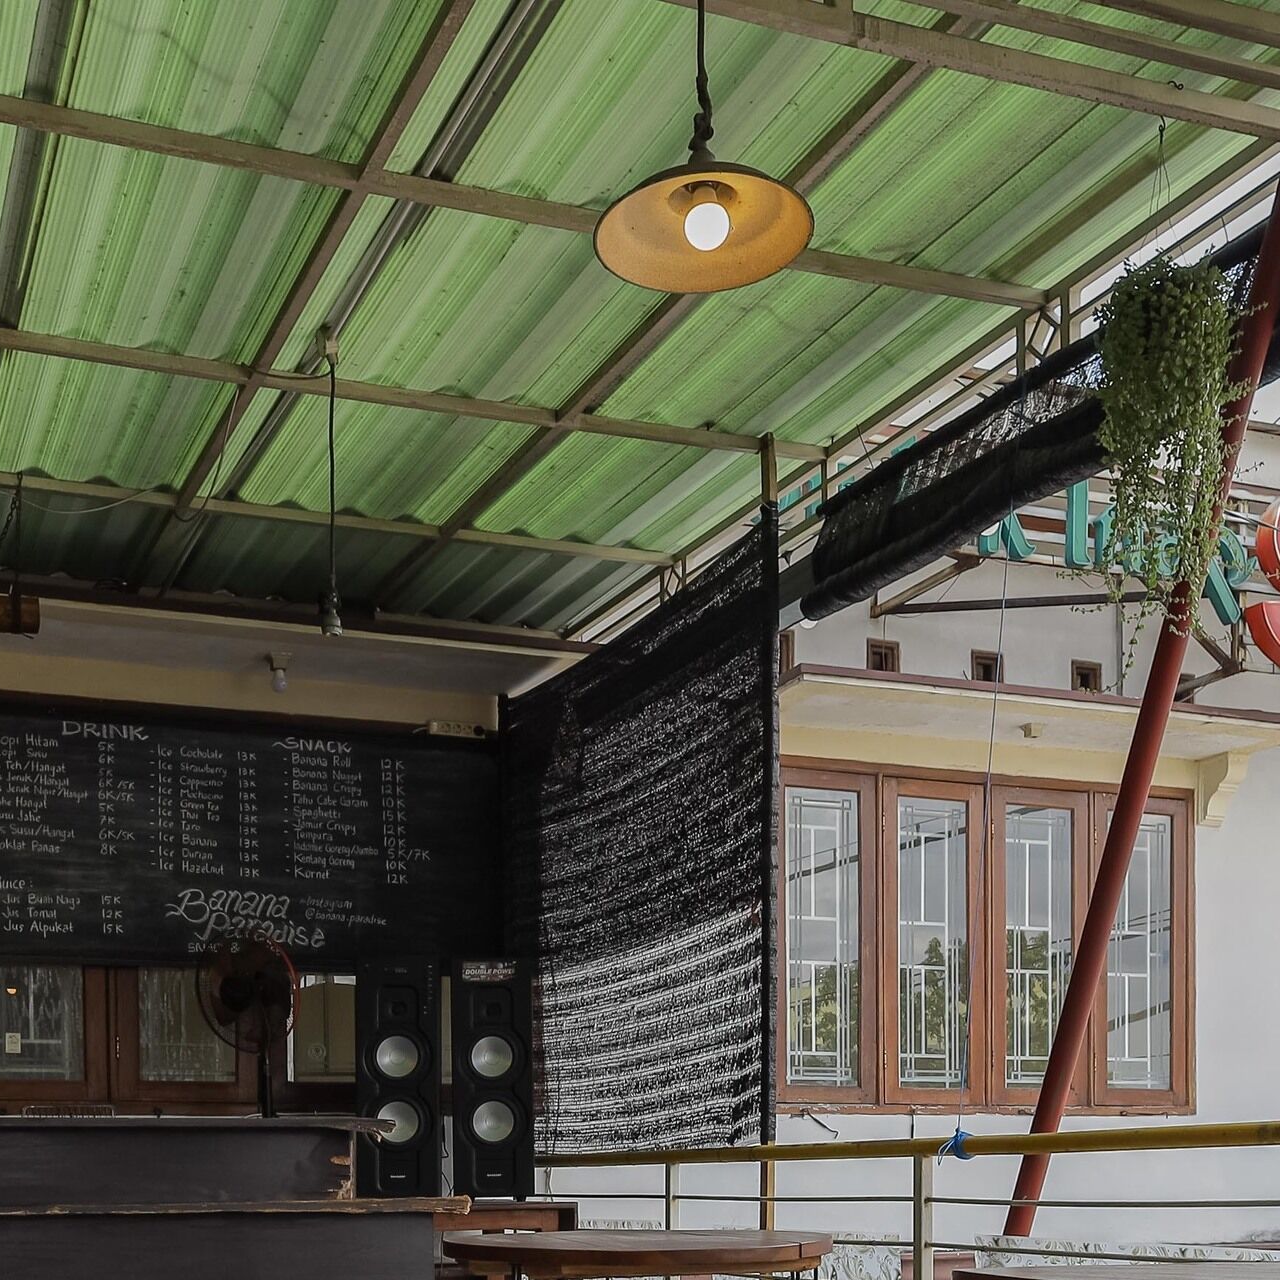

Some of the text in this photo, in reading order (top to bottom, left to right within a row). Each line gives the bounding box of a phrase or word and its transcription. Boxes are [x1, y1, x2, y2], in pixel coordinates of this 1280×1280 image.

[61, 721, 149, 741] DRINK
[25, 733, 59, 747] Hitam
[98, 741, 115, 752] 5K
[157, 744, 172, 757] Ice
[272, 737, 353, 754] SNACK
[26, 748, 48, 759] Susu
[98, 753, 115, 764] 6K
[291, 752, 328, 767] Banana
[333, 755, 351, 768] Roll
[158, 759, 173, 770] Ice
[158, 772, 172, 783] Ice
[292, 767, 328, 779] Banana
[158, 785, 173, 795] Ice
[292, 779, 328, 792] Banana
[333, 782, 361, 797] Crispy
[158, 795, 173, 806] Ice
[180, 799, 204, 809] Green
[207, 801, 219, 811] Tea
[292, 792, 314, 805] Tahu
[99, 803, 114, 812] 5K
[158, 806, 172, 817] Ice
[180, 809, 198, 820] Thai
[207, 812, 220, 822] Tea
[293, 805, 341, 820] Spaghetti
[17, 809, 41, 822] Jahe
[99, 815, 115, 825] 7K
[159, 818, 174, 828] Ice
[181, 820, 201, 831] Taro
[98, 828, 135, 841] 6K/5K
[291, 818, 323, 829] Jamur
[326, 819, 356, 837] Crispy
[293, 828, 333, 843] Tempura
[159, 831, 175, 842] Ice
[182, 833, 218, 847] Banana
[31, 840, 61, 853] Panas
[100, 842, 117, 855] 8K
[159, 845, 175, 857] Ice
[182, 848, 213, 860] Durian
[159, 858, 174, 870] Ice
[182, 860, 224, 876] Hazelnut
[294, 852, 326, 868] Kentang
[328, 855, 355, 870] Goreng
[294, 864, 329, 879] Kornet
[2, 893, 20, 904] Jus
[56, 895, 80, 910] Naga
[165, 888, 290, 923] Banana
[2, 906, 19, 919] Jus
[27, 907, 56, 919] Tomat
[4, 920, 24, 933] Jus
[30, 921, 74, 939] Alpukat
